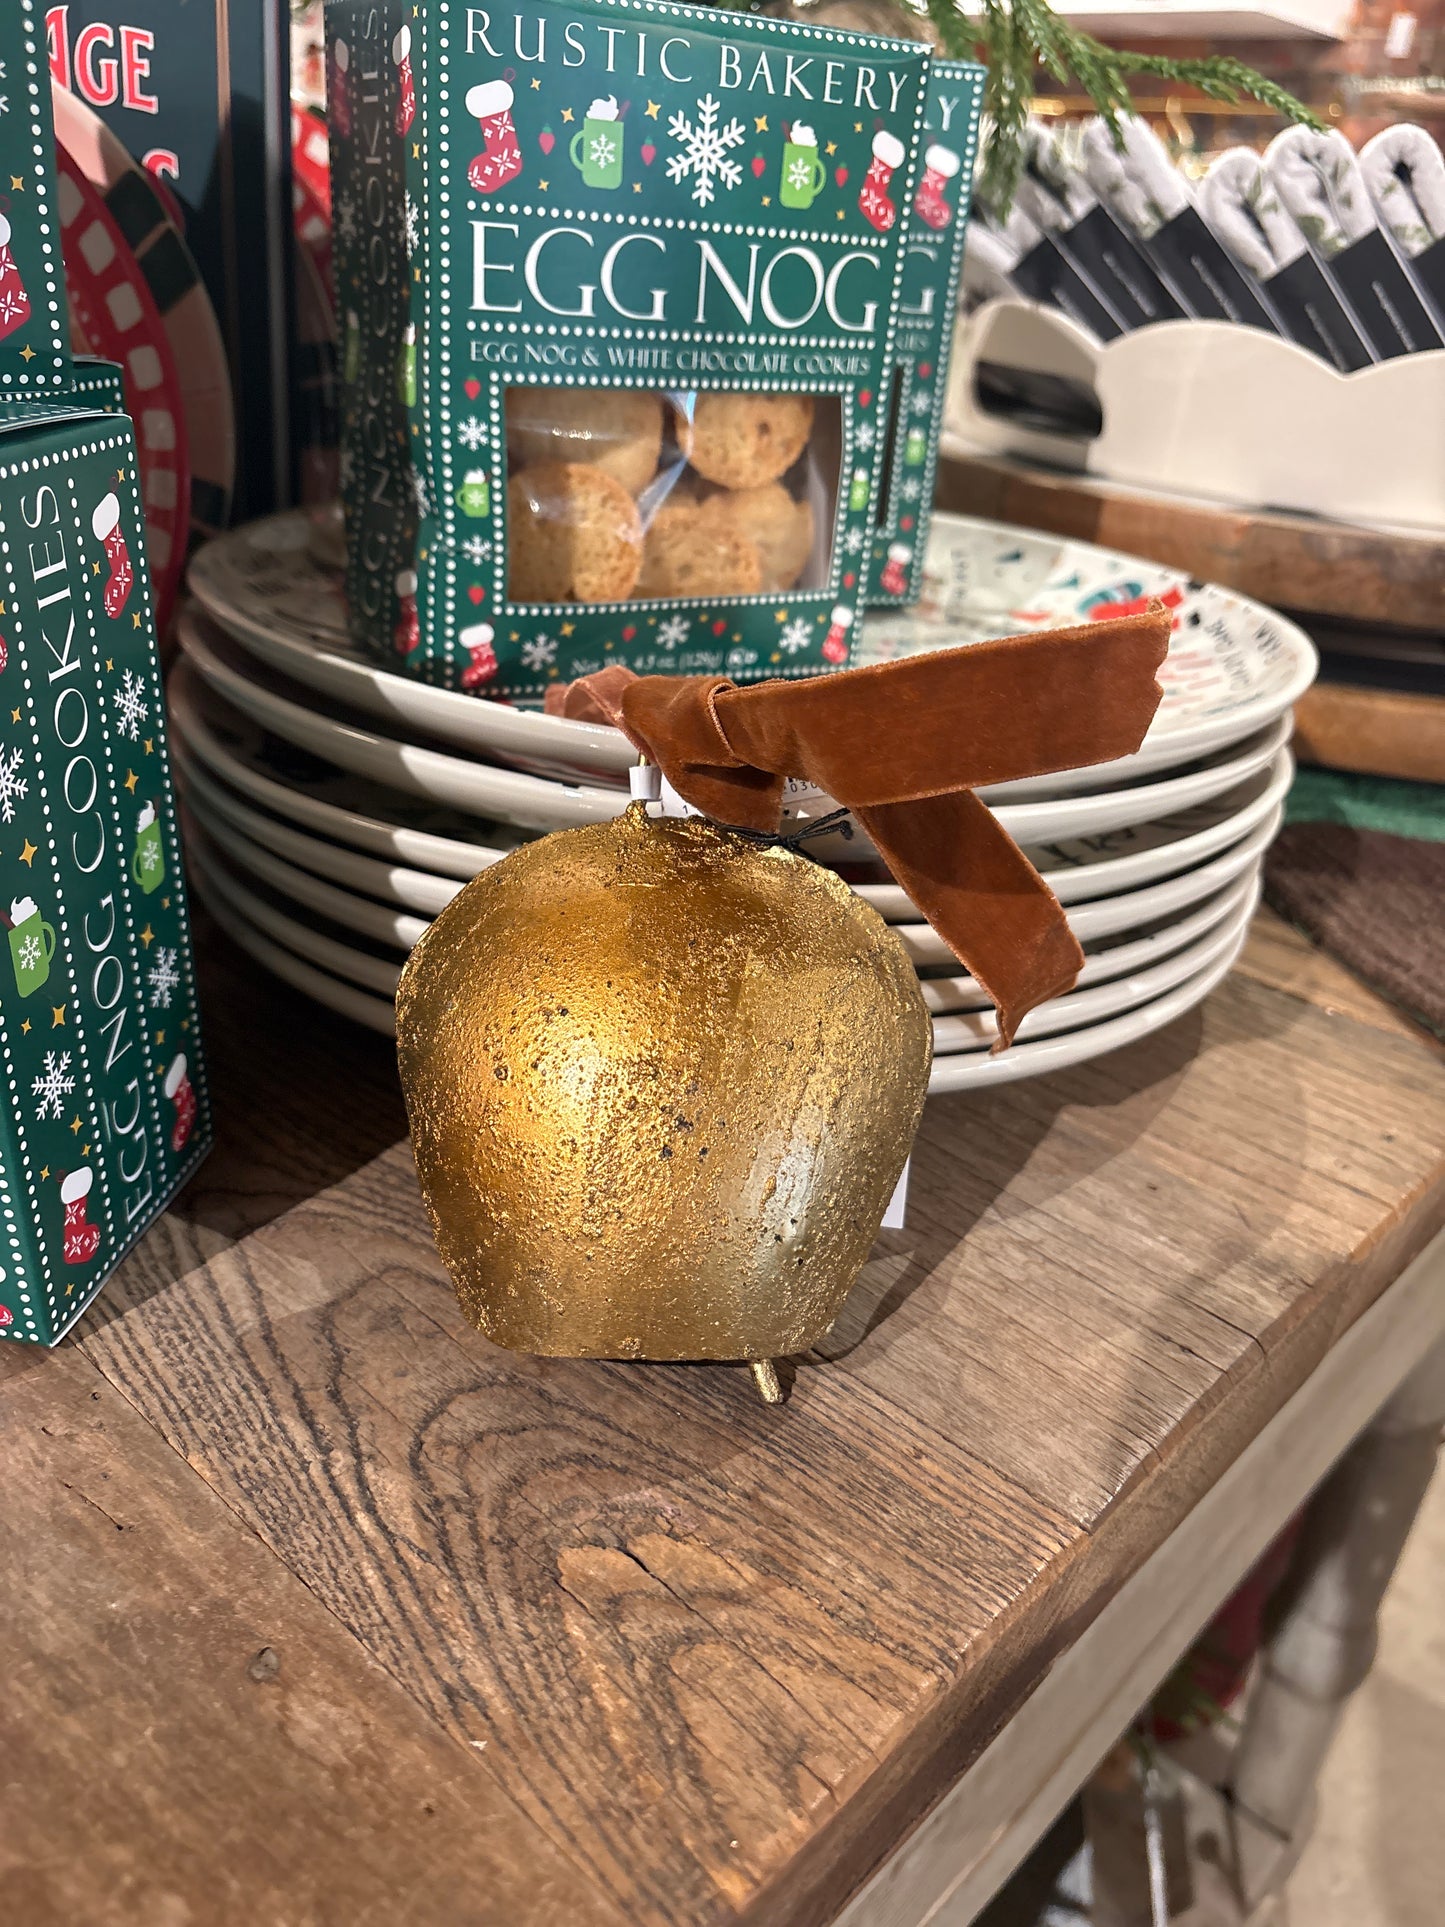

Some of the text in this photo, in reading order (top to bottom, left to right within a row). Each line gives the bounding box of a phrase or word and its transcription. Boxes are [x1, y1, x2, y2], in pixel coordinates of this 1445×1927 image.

[464, 7, 908, 113] RUSTIC BAKERY
[468, 220, 669, 323] EGG
[694, 239, 882, 333] NOG
[470, 340, 871, 376] EGG NOG & WHITE CHOCOLATE COOKIES
[20, 485, 154, 1223] EGG NOG COOKIES
